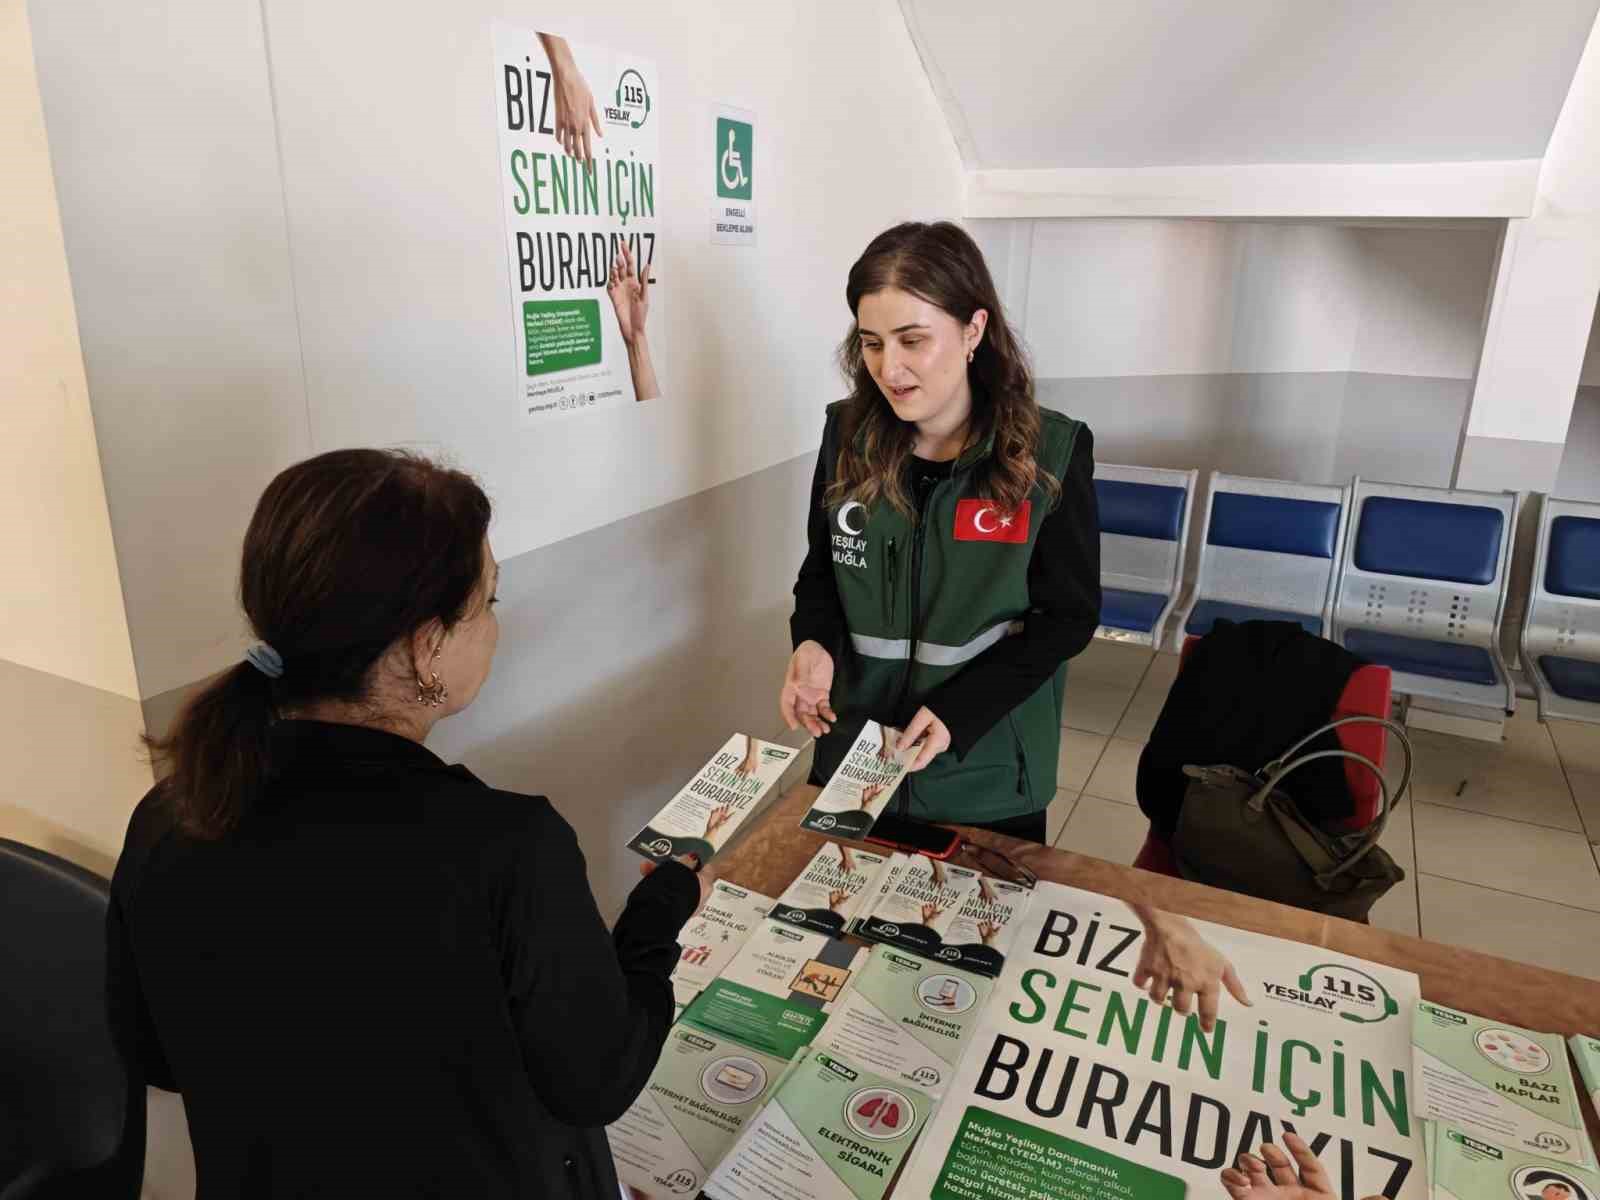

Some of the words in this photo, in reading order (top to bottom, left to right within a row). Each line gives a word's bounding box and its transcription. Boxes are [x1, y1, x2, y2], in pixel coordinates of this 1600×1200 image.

[504, 56, 554, 135] BİZ
[624, 85, 643, 104] 115
[605, 148, 655, 226] İÇİN
[832, 534, 867, 552] YEŞİLAY
[1032, 908, 1142, 978] BİZ
[1323, 975, 1376, 1002] 115
[1251, 1020, 1412, 1138] İÇİN
[1519, 1078, 1560, 1094] BAZI
[1495, 1082, 1561, 1105] HAPLAR
[818, 1126, 893, 1166] ELEKTRONİK
[964, 1131, 1008, 1151] Merkezi
[1010, 1146, 1064, 1171] (YEDAM)
[967, 1120, 1002, 1139] Muğla
[1005, 1134, 1045, 1155] Yeşilay
[1048, 1146, 1119, 1179] Danışmanlık
[838, 1150, 884, 1177] SİGARA
[674, 1173, 692, 1186] 115
[947, 1172, 985, 1191] sosyal
[980, 1170, 1027, 1194] ücretsiz
